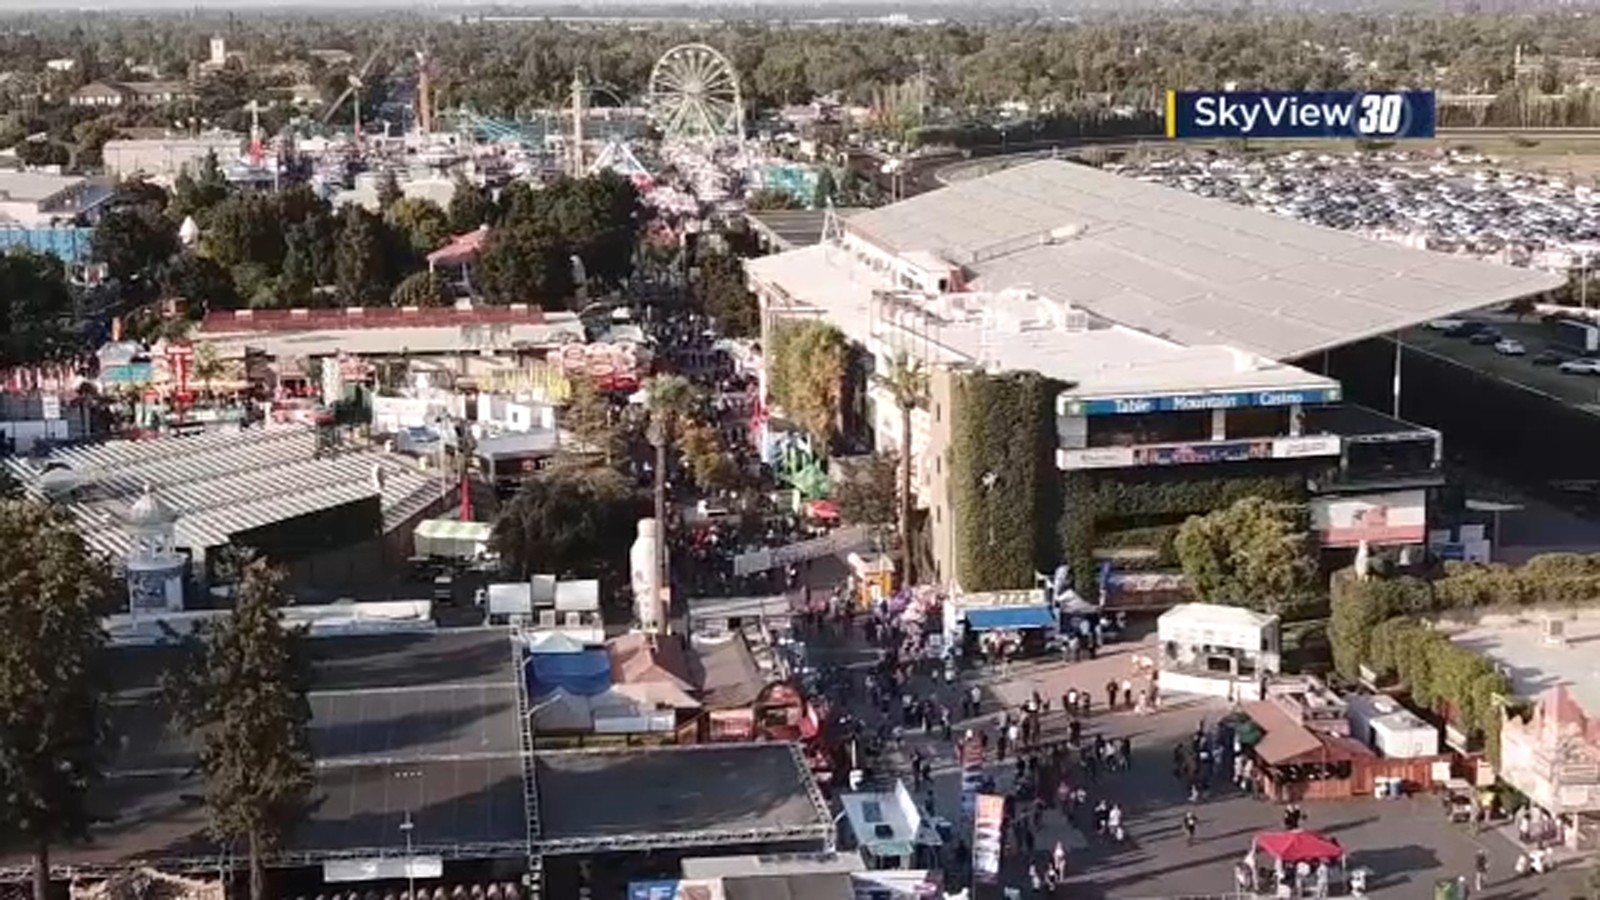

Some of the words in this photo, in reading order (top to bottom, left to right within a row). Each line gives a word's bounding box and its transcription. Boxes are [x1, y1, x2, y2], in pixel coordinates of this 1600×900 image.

[1113, 399, 1151, 413] Table
[1173, 395, 1237, 411] Mountain
[1259, 391, 1304, 406] Casino
